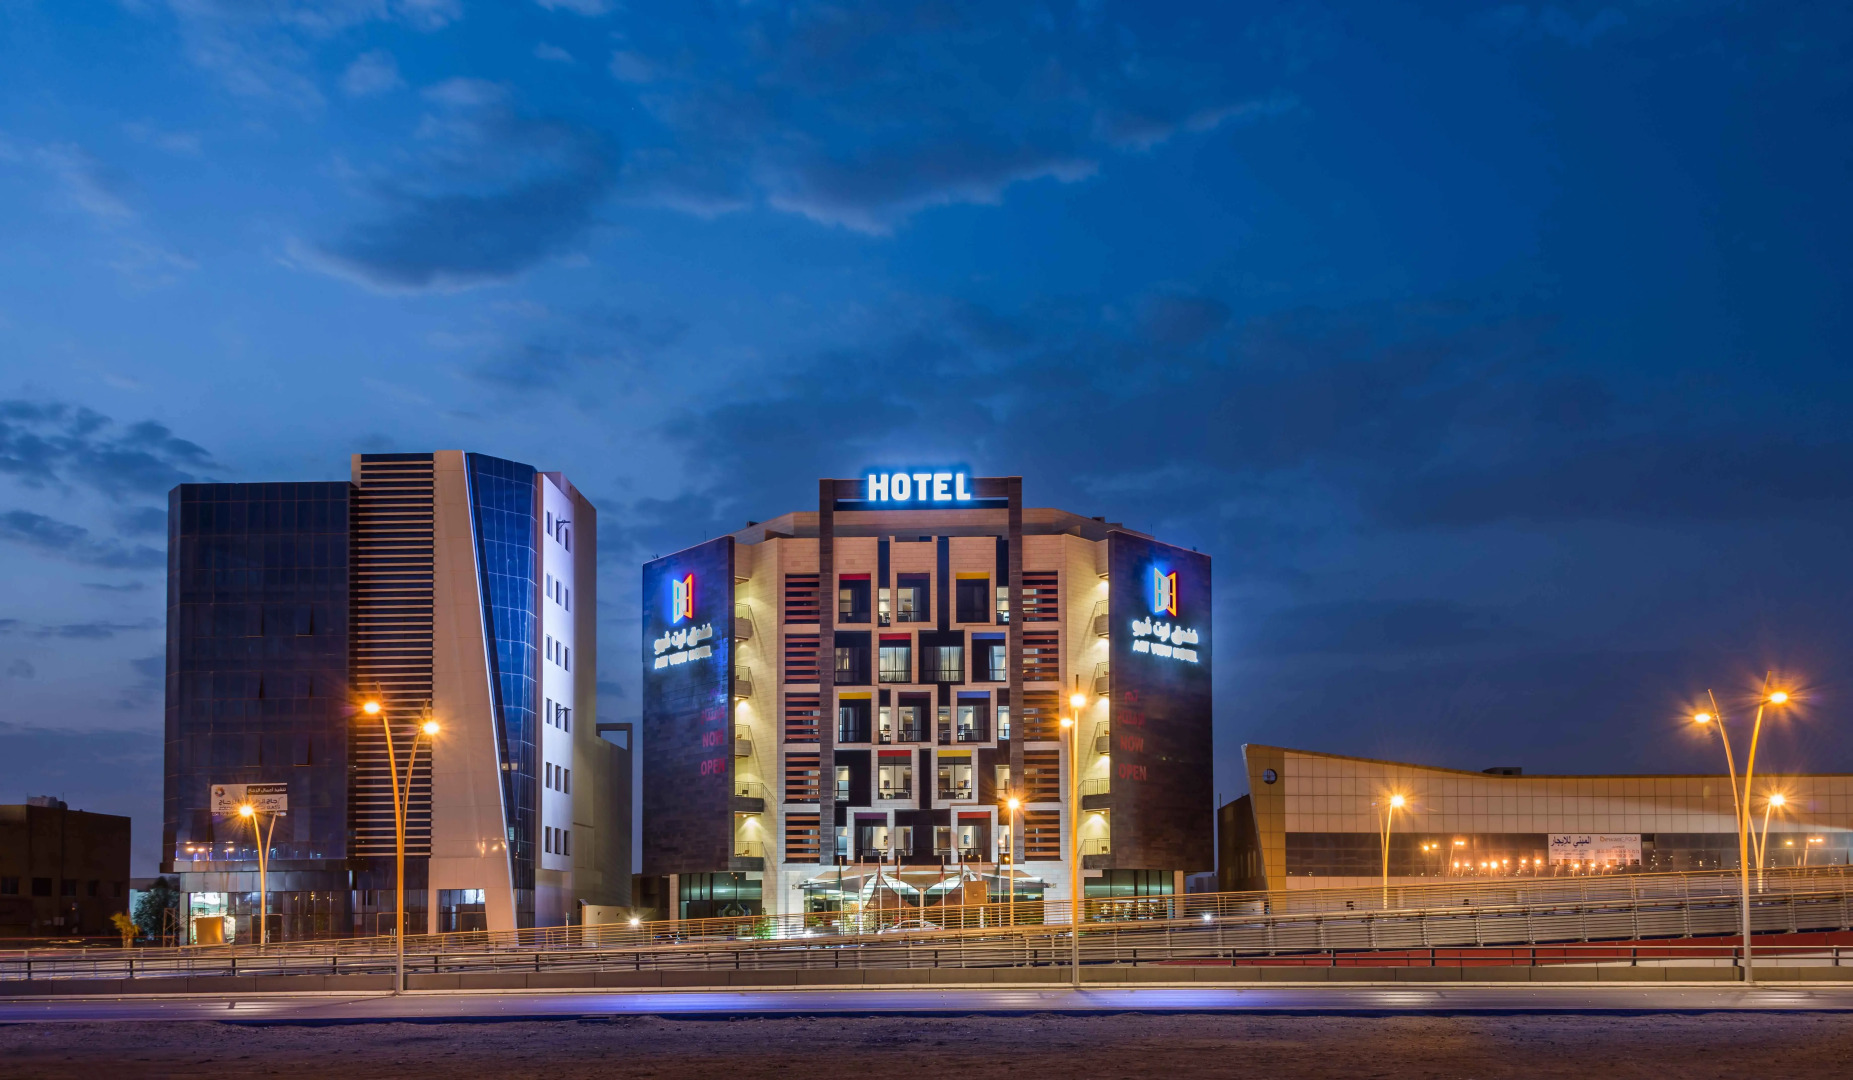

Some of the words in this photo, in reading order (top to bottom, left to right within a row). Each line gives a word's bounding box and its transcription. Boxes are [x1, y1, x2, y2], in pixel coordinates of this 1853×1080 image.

[868, 473, 971, 501] HOTEL
[702, 728, 724, 748] NOW
[1120, 735, 1144, 753] NOW
[700, 757, 726, 776] OPEN
[1118, 763, 1147, 781] OPEN
